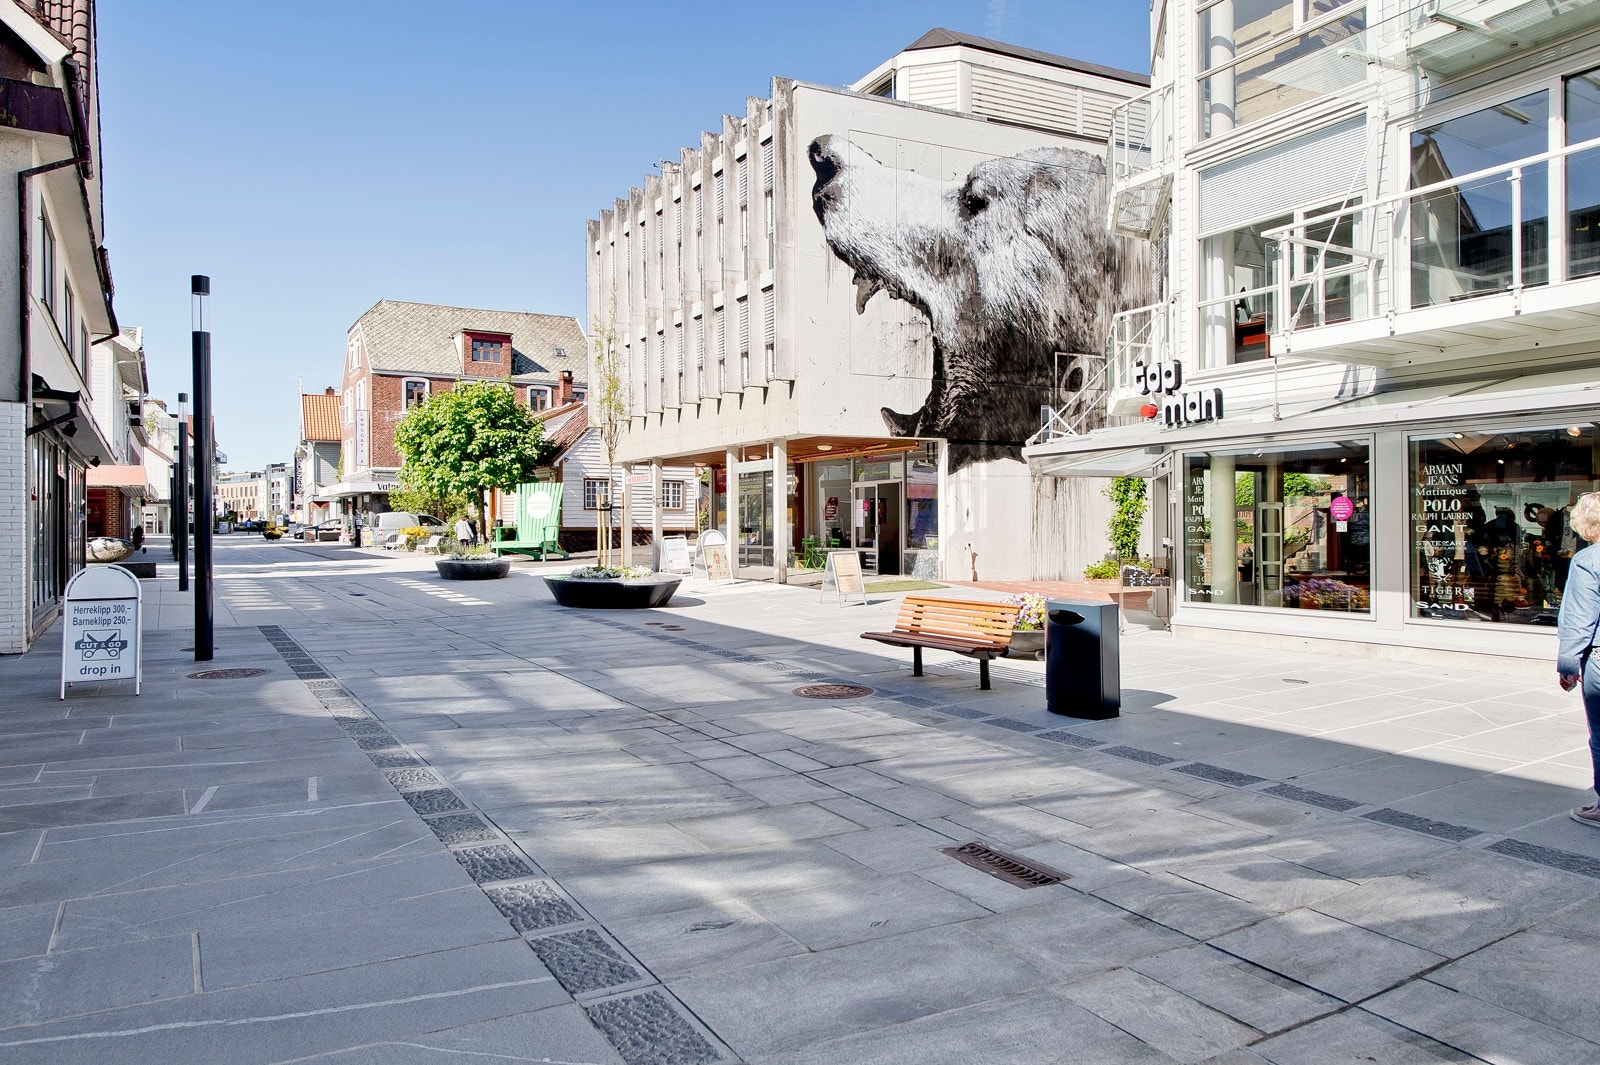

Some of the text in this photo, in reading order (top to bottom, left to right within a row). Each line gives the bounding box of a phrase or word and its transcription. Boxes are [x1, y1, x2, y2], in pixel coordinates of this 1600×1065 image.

[1132, 359, 1182, 396] top
[1162, 387, 1223, 428] man
[1422, 464, 1463, 475] ARMANI
[1426, 475, 1459, 486] JEANS
[1416, 488, 1467, 496] Matinique
[1422, 499, 1461, 512] POLO
[1412, 512, 1474, 520] RALPH LAUREN
[1416, 524, 1468, 532] GANT
[1422, 586, 1463, 595] TIGER
[74, 605, 110, 615] Herreklipp
[1416, 601, 1470, 610] SAND
[72, 616, 112, 626] Barneklipp
[80, 664, 121, 676] drop in
